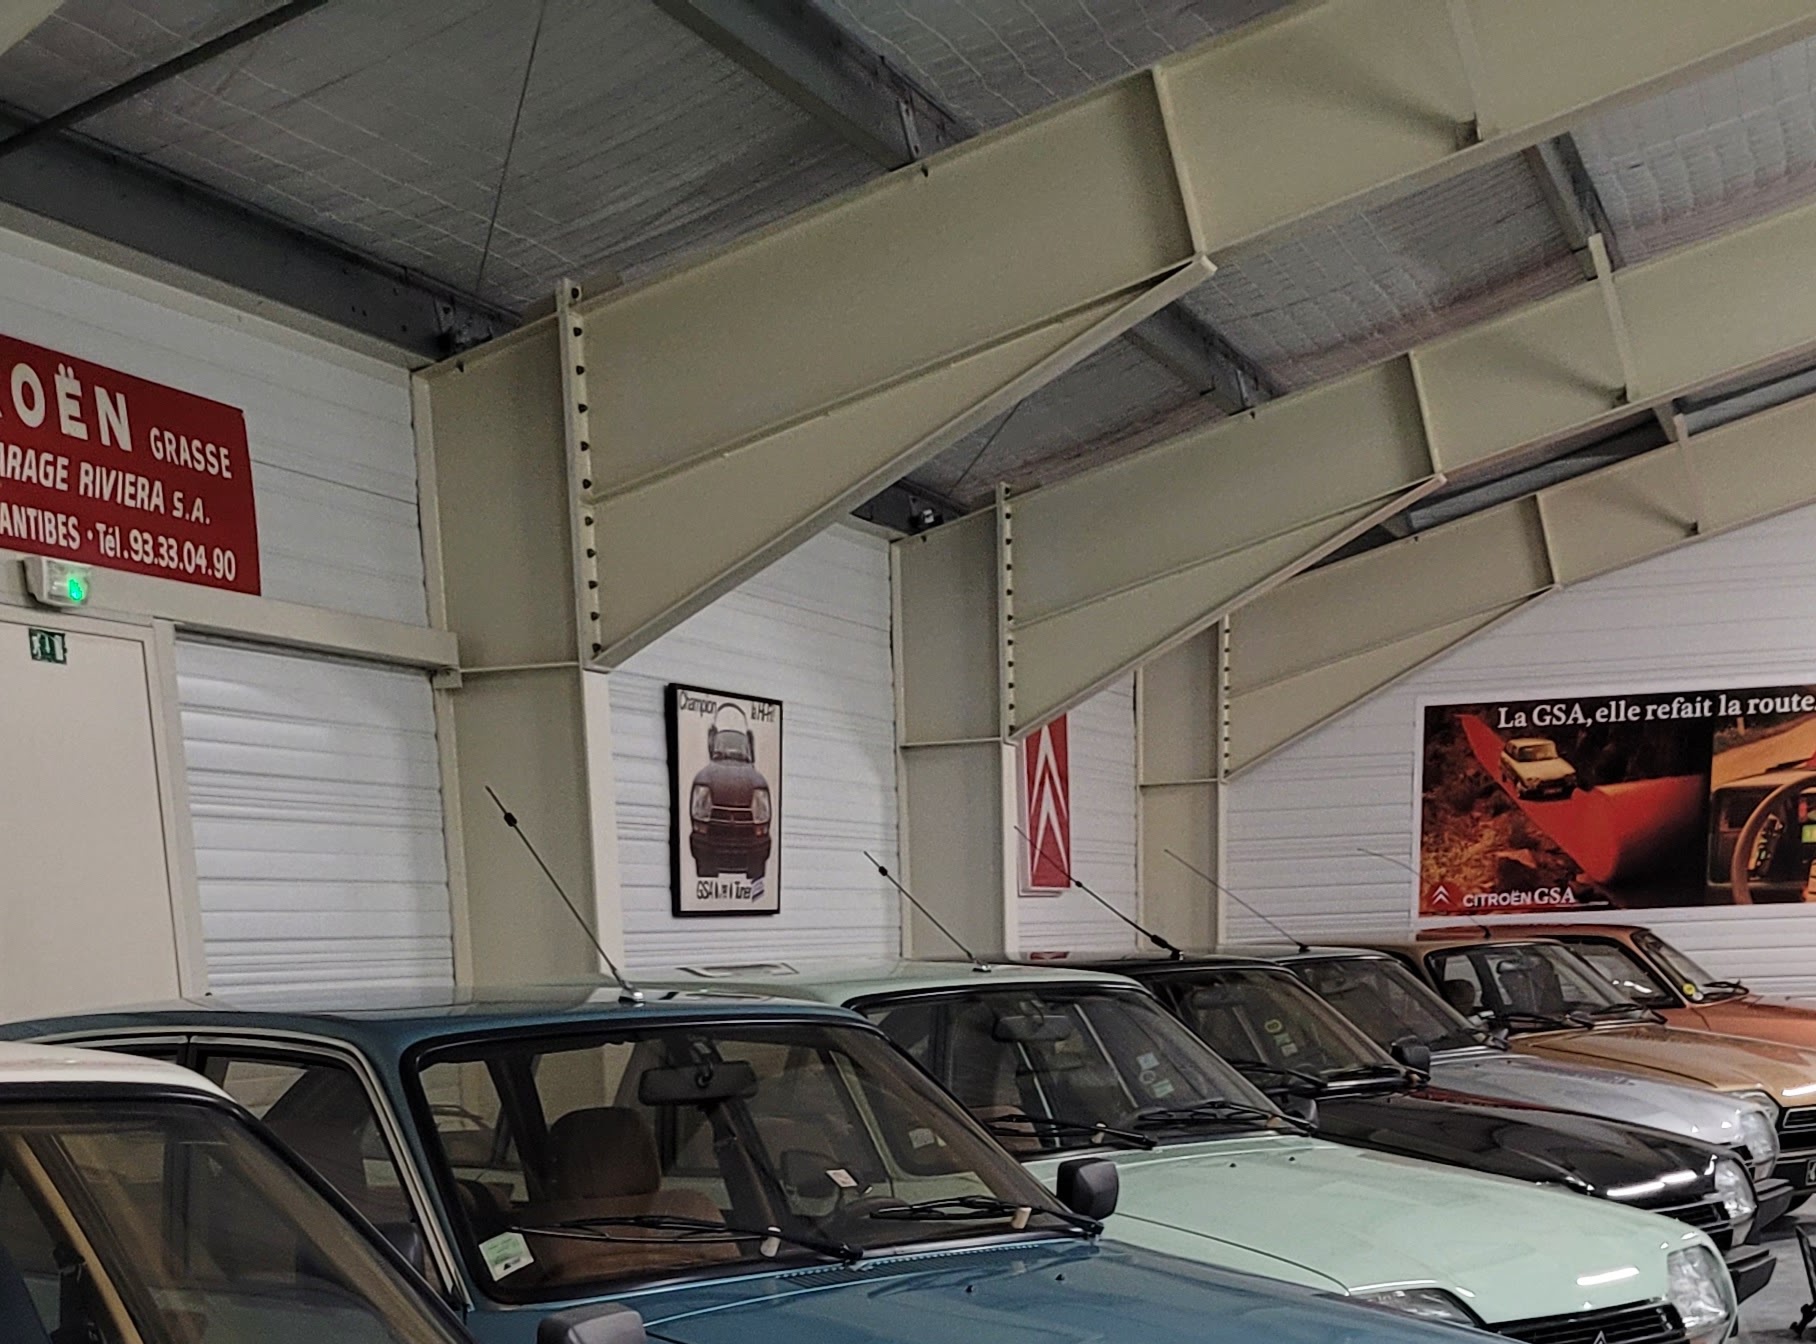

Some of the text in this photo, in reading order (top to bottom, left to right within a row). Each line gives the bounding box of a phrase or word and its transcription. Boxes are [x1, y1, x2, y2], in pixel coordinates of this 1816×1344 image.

[0, 362, 232, 479] OËN GRASSE
[79, 461, 165, 515] RIVIERA
[172, 491, 211, 525] S.A.
[0, 502, 81, 550] ANTIBES
[1497, 707, 1528, 728] La
[1532, 702, 1593, 727] GSA,
[1595, 700, 1641, 722] elle
[1645, 696, 1713, 720] refait
[1718, 694, 1743, 717] la
[1463, 886, 1577, 908] CITROËN GSA
